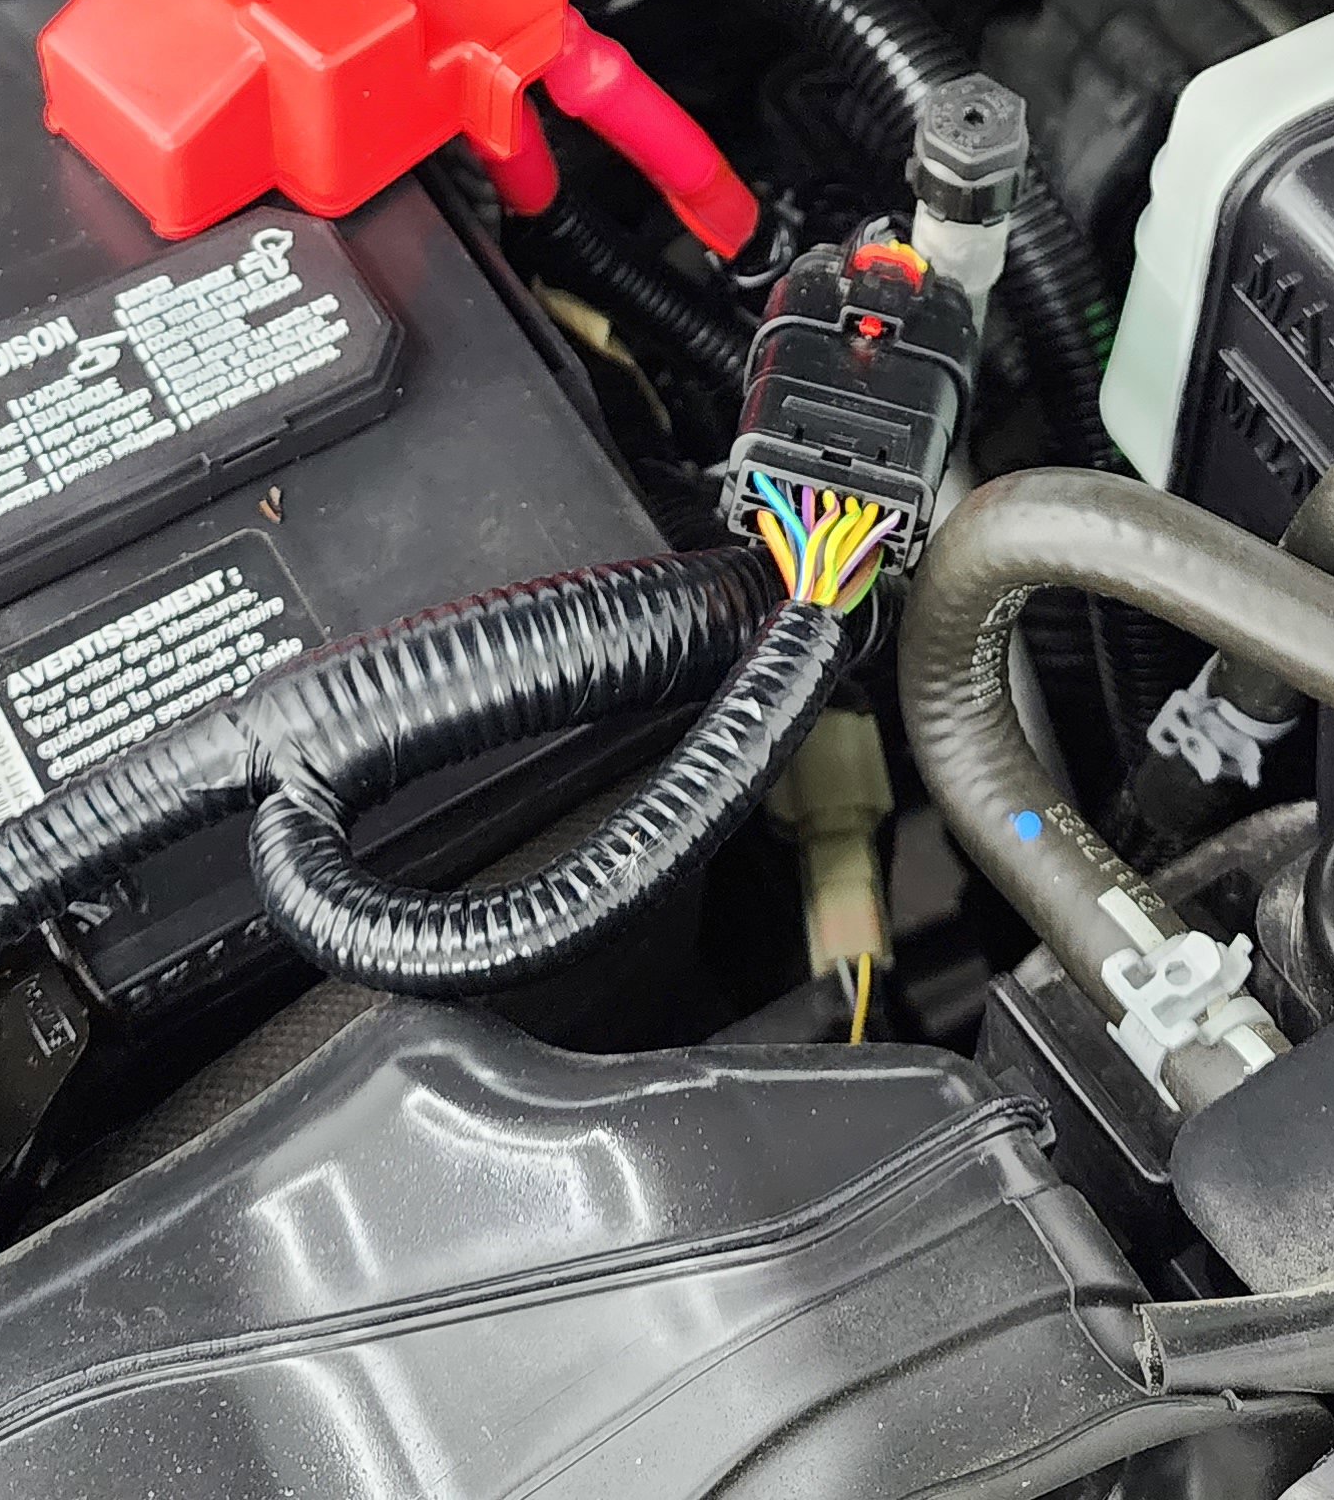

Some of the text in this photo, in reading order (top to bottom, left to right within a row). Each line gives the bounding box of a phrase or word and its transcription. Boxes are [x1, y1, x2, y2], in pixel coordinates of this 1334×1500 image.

[29, 377, 123, 432] SULFURIQUE
[59, 449, 113, 484] GRAVES
[7, 570, 224, 698] AVERTISSEMENT
[127, 690, 152, 711] la
[236, 633, 264, 655] de
[14, 682, 65, 718] Pour
[123, 635, 161, 663] des
[23, 707, 67, 737] Voir
[67, 697, 89, 718] le
[90, 667, 146, 710] guide
[147, 652, 175, 677] du
[155, 674, 234, 724] secours
[246, 638, 302, 676] l'aide
